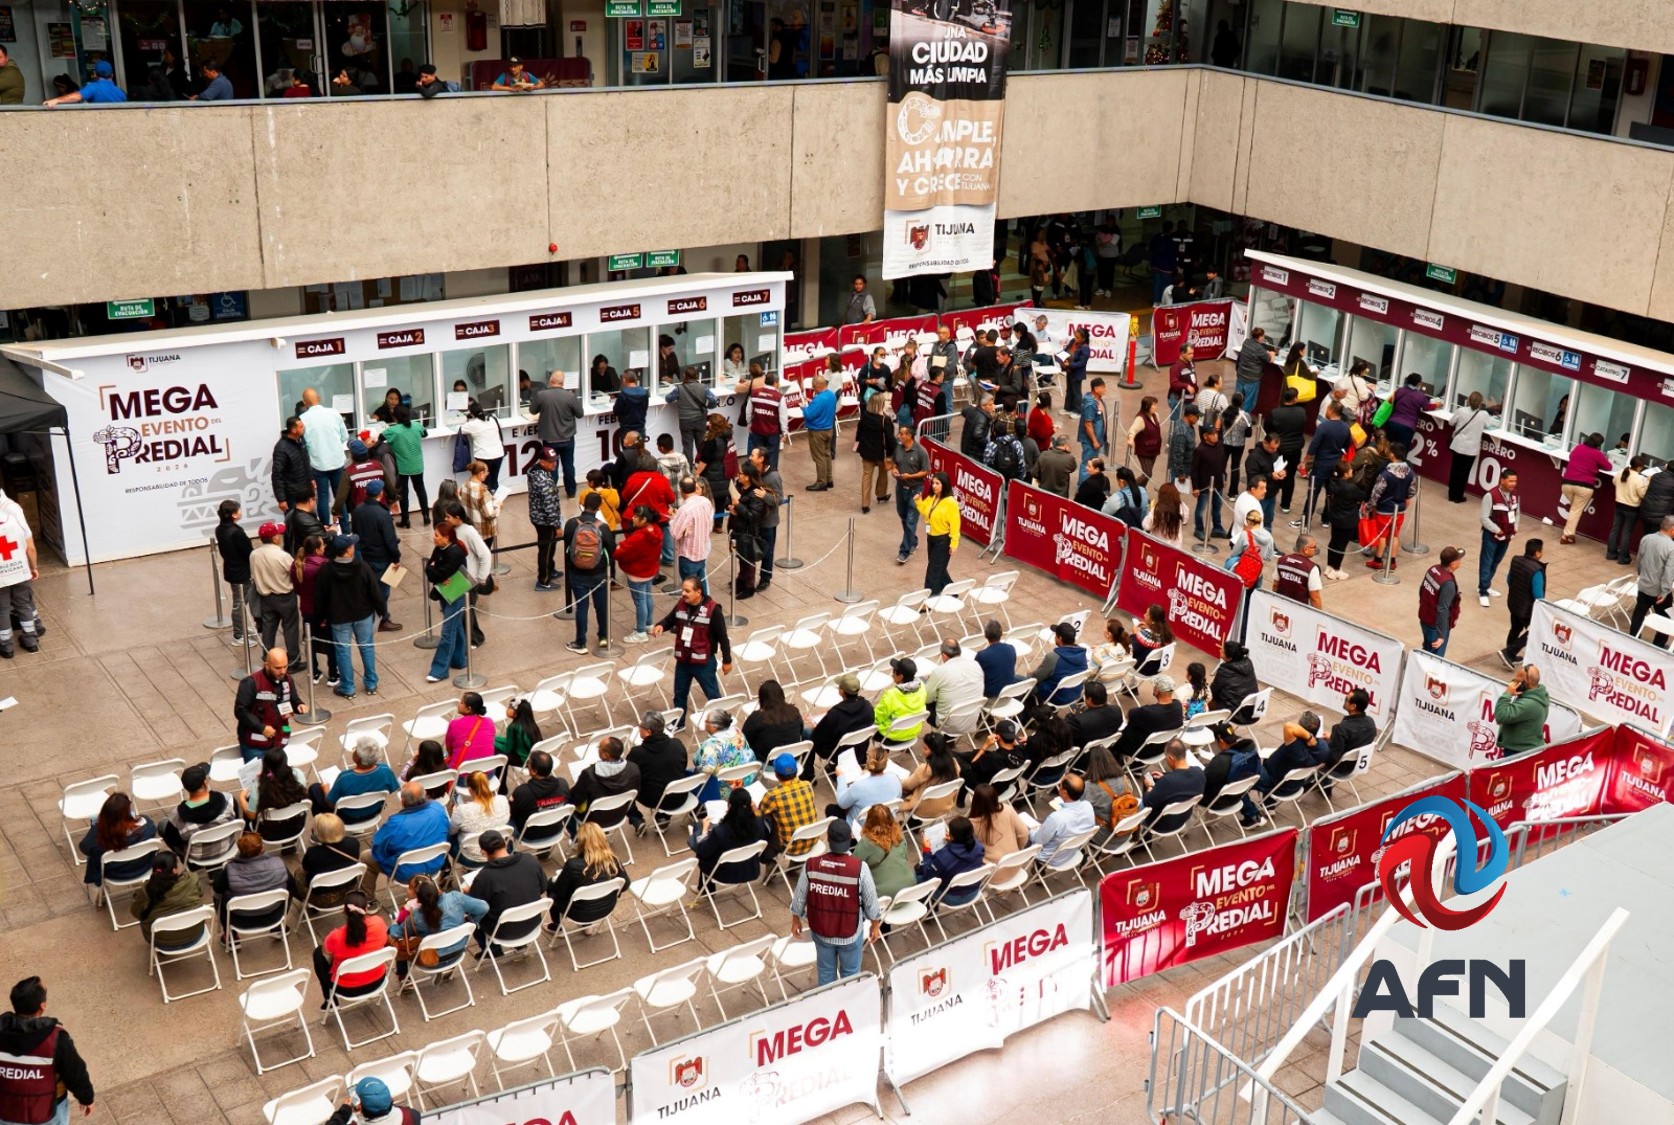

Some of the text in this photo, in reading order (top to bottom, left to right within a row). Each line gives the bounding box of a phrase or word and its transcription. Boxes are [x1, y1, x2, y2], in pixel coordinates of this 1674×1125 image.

[912, 42, 988, 64] CIUDAD
[910, 64, 944, 85] MÁS
[896, 172, 982, 196] Y CRECE CON
[935, 222, 975, 235] TIJUANA
[741, 291, 769, 303] CAJA 7
[1328, 286, 1334, 296] 2
[609, 307, 640, 319] CAJA 5
[676, 298, 706, 311] CAJA 6
[1380, 302, 1386, 312] 3
[466, 324, 495, 335] CAJA 3
[539, 315, 568, 327] CAJA 4
[1192, 312, 1225, 327] MEGA
[1436, 317, 1442, 327] 4
[307, 341, 343, 354] CAJA 1
[388, 331, 424, 344] CAJA 2
[1188, 330, 1222, 347] PREDIAL
[1493, 332, 1500, 344] 5
[148, 354, 180, 363] TIJUANA
[1532, 345, 1562, 362] RECIBOS 6
[1620, 369, 1627, 380] 7
[109, 384, 218, 420] MEGA
[141, 416, 209, 437] EVENTO
[93, 425, 222, 474] PREDIAL
[125, 482, 178, 494] RESPONSABILIDAD
[188, 477, 208, 486] TODOS
[957, 469, 992, 503] MEGA
[965, 494, 988, 512] EVENTO
[1018, 516, 1046, 535] TIJUANA
[1062, 515, 1109, 553] MEGA
[1053, 533, 1107, 581] PREDIAL
[1072, 542, 1103, 562] EVENTO
[1133, 568, 1162, 589] TIJUANA
[1177, 569, 1227, 610] MEGA
[1167, 587, 1222, 640] PREDIAL
[1188, 597, 1220, 620] EVENTO
[1074, 620, 1081, 632] 2
[1261, 632, 1297, 654] TIJUANA
[1317, 632, 1381, 674] MEGA
[1162, 653, 1170, 667] 3
[1542, 642, 1578, 666] TIJUANA
[1332, 660, 1374, 685] EVENTO
[1600, 646, 1666, 691] MEGA
[1586, 665, 1659, 724] PREDIAL
[1614, 677, 1656, 700] EVENTO
[1257, 700, 1265, 713] 4
[1415, 697, 1456, 721] TIJUANA
[1358, 755, 1367, 770] 5
[1537, 752, 1595, 790] MEGA
[1622, 771, 1666, 800] TIJUANA
[1319, 855, 1361, 878] TIJUANA
[1196, 857, 1275, 899] MEGA
[810, 883, 850, 898] PREDIAL
[1216, 886, 1266, 911] EVENTO
[1115, 910, 1166, 933] TIJUANA
[1179, 900, 1272, 947] PREDIAL
[990, 923, 1069, 976] MEGA
[910, 994, 963, 1026] TIJUANA
[757, 1010, 854, 1067] MEGA
[0, 1067, 45, 1080] REDIAL
[658, 1087, 722, 1120] TIJUANA
